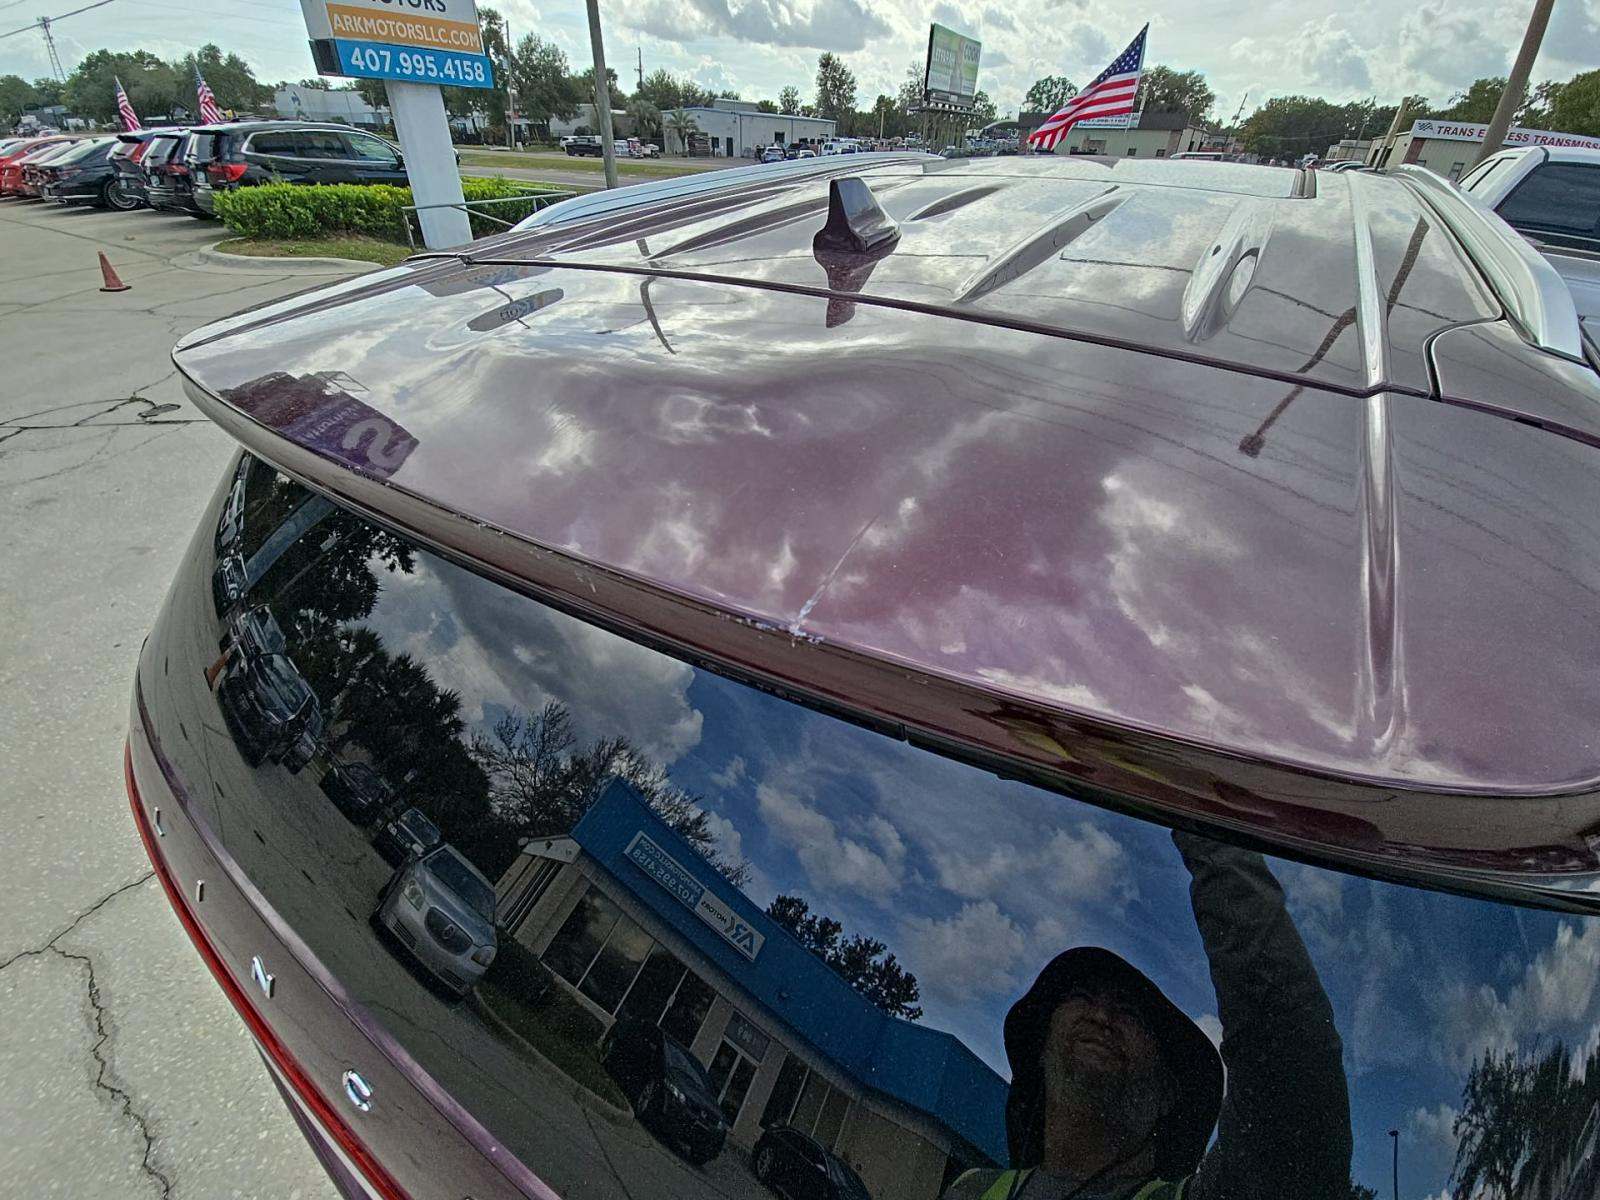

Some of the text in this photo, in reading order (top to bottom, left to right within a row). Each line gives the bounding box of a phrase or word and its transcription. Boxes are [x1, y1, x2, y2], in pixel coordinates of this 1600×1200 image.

[333, 14, 481, 48] ARKMOTORSLLC.COM
[351, 47, 485, 82] 407.995.4158
[1437, 126, 1474, 137] TRANS
[1534, 135, 1600, 149] TRANSMISS
[153, 806, 375, 1112] LINC
